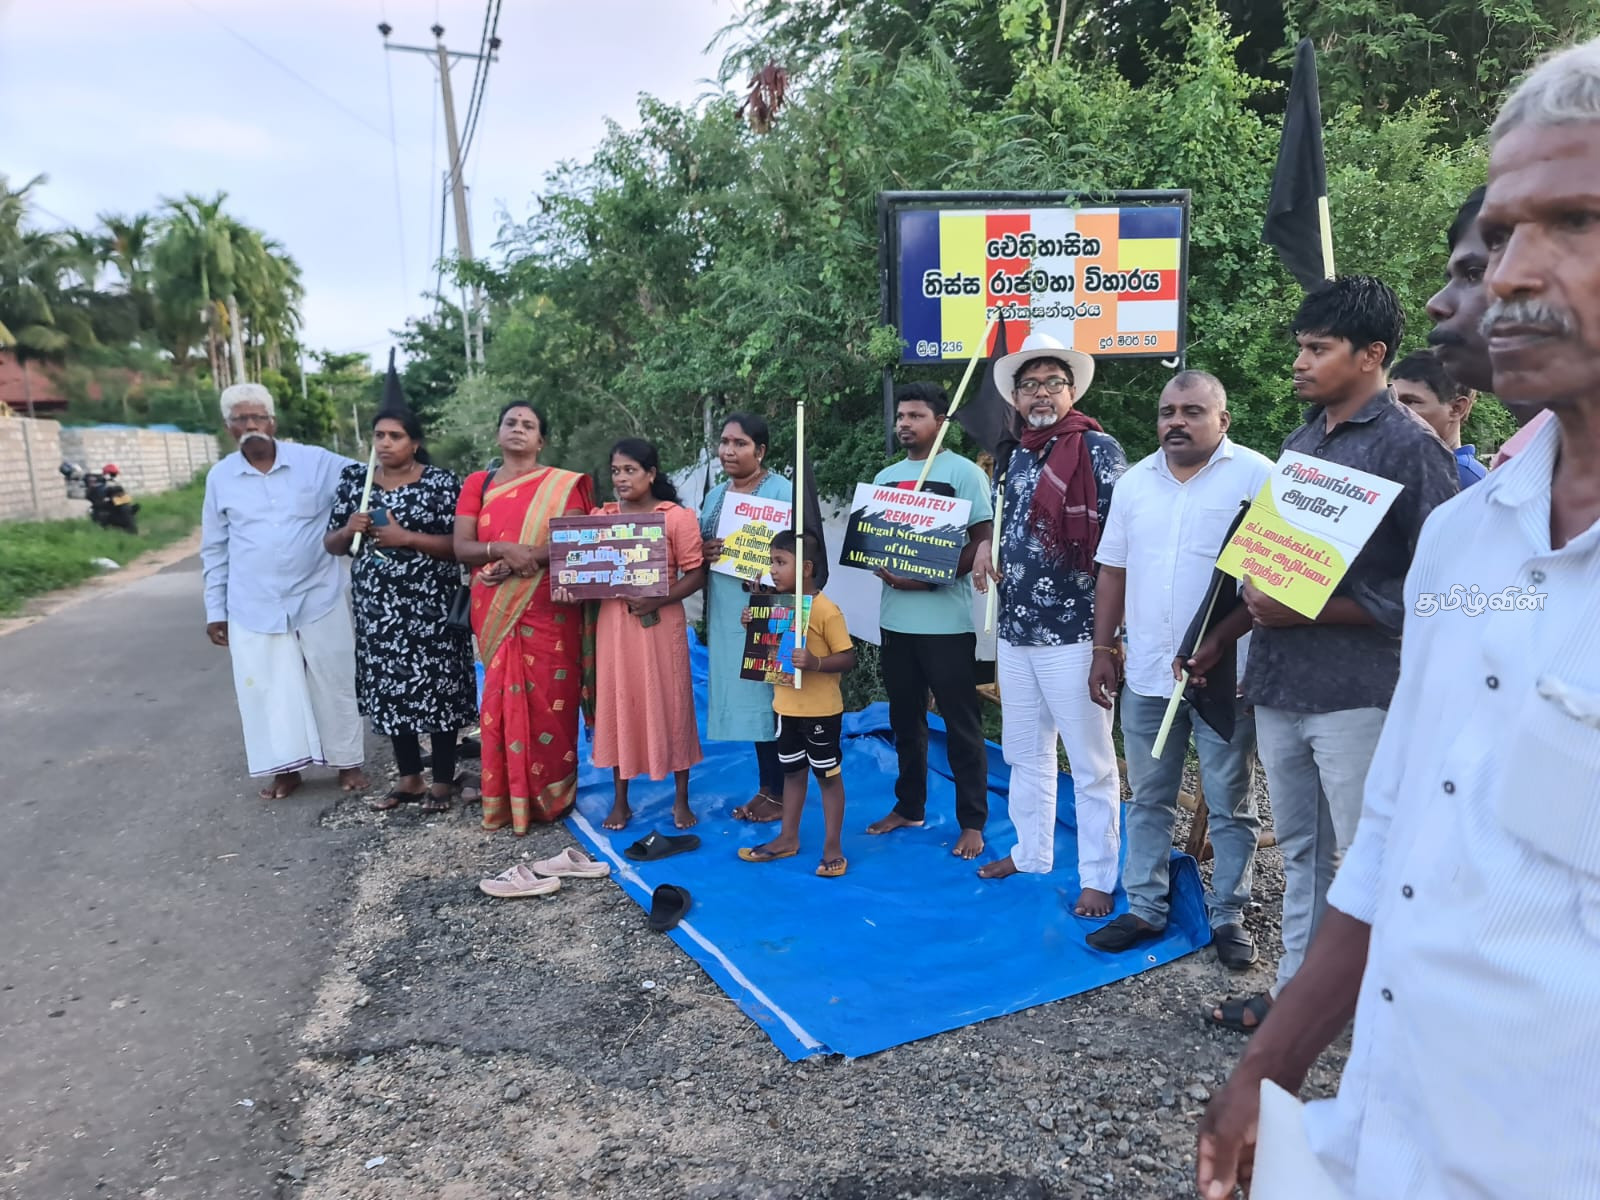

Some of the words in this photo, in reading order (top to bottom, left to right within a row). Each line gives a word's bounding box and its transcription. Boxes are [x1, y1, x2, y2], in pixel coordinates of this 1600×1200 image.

[987, 232, 1101, 258] ඓතිහාසික
[923, 271, 981, 297] තිස්ස
[990, 269, 1076, 294] රාජමහා
[1084, 267, 1160, 292] විහාරය
[942, 341, 962, 352] 236
[1143, 335, 1157, 346] 50
[1281, 462, 1380, 505] சிறிலங்கா
[872, 489, 956, 513] IMMEDIATELY
[1281, 489, 1348, 523] அரசே!
[884, 509, 935, 528] REMOVE
[856, 521, 894, 538] Illegal
[895, 527, 956, 549] Structure
[1244, 522, 1333, 568] கட்டமைக்கப்பட்ட
[884, 542, 898, 553] of
[898, 544, 918, 557] the
[1231, 534, 1272, 558] தமிழின
[1272, 552, 1332, 587] அழிப்பை
[846, 550, 889, 568] Alleged
[891, 557, 946, 579] Viharaya
[1240, 557, 1286, 587] நிறுத்து
